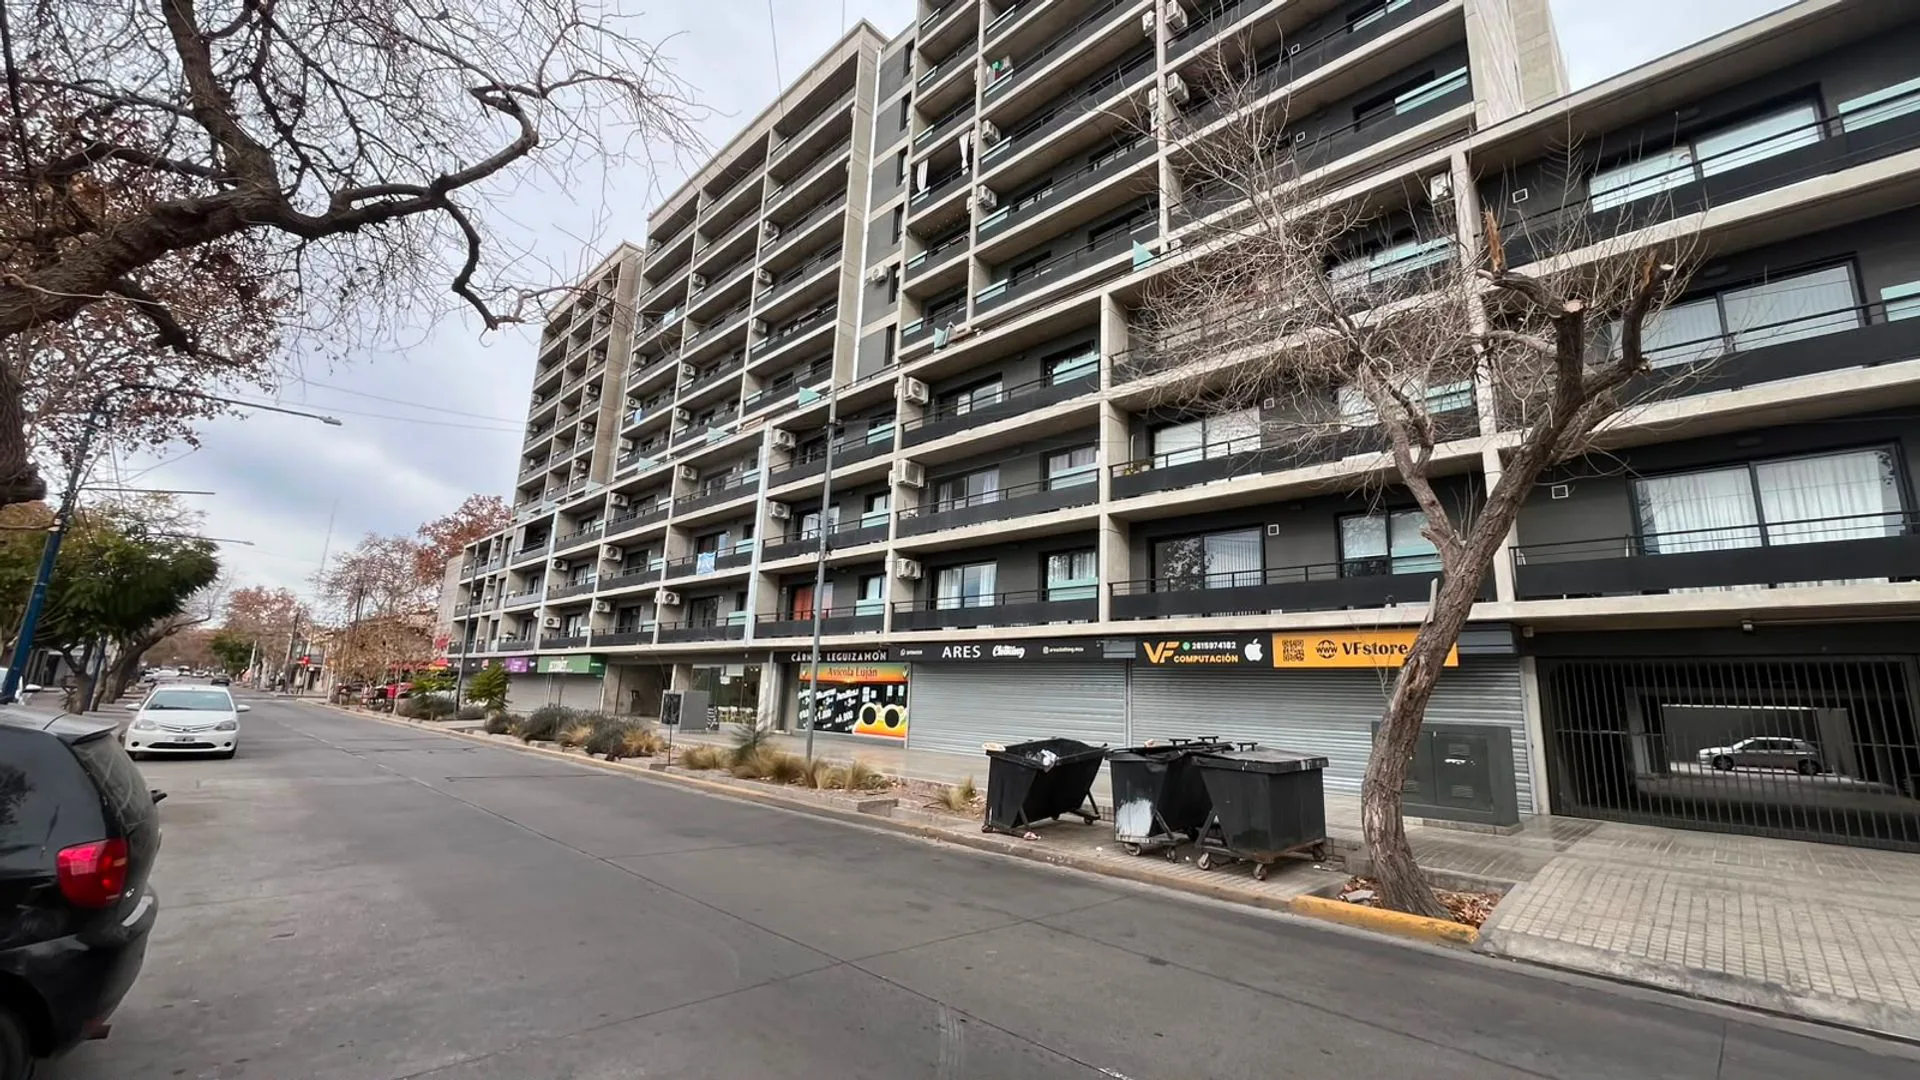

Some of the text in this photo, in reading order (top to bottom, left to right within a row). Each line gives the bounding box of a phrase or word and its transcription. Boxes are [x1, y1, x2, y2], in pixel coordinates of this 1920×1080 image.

[827, 650, 887, 661] LEGUIZAMÓN
[942, 645, 981, 659] ARES
[1143, 641, 1180, 664] VF
[1174, 653, 1239, 663] COMPUTACIÓN
